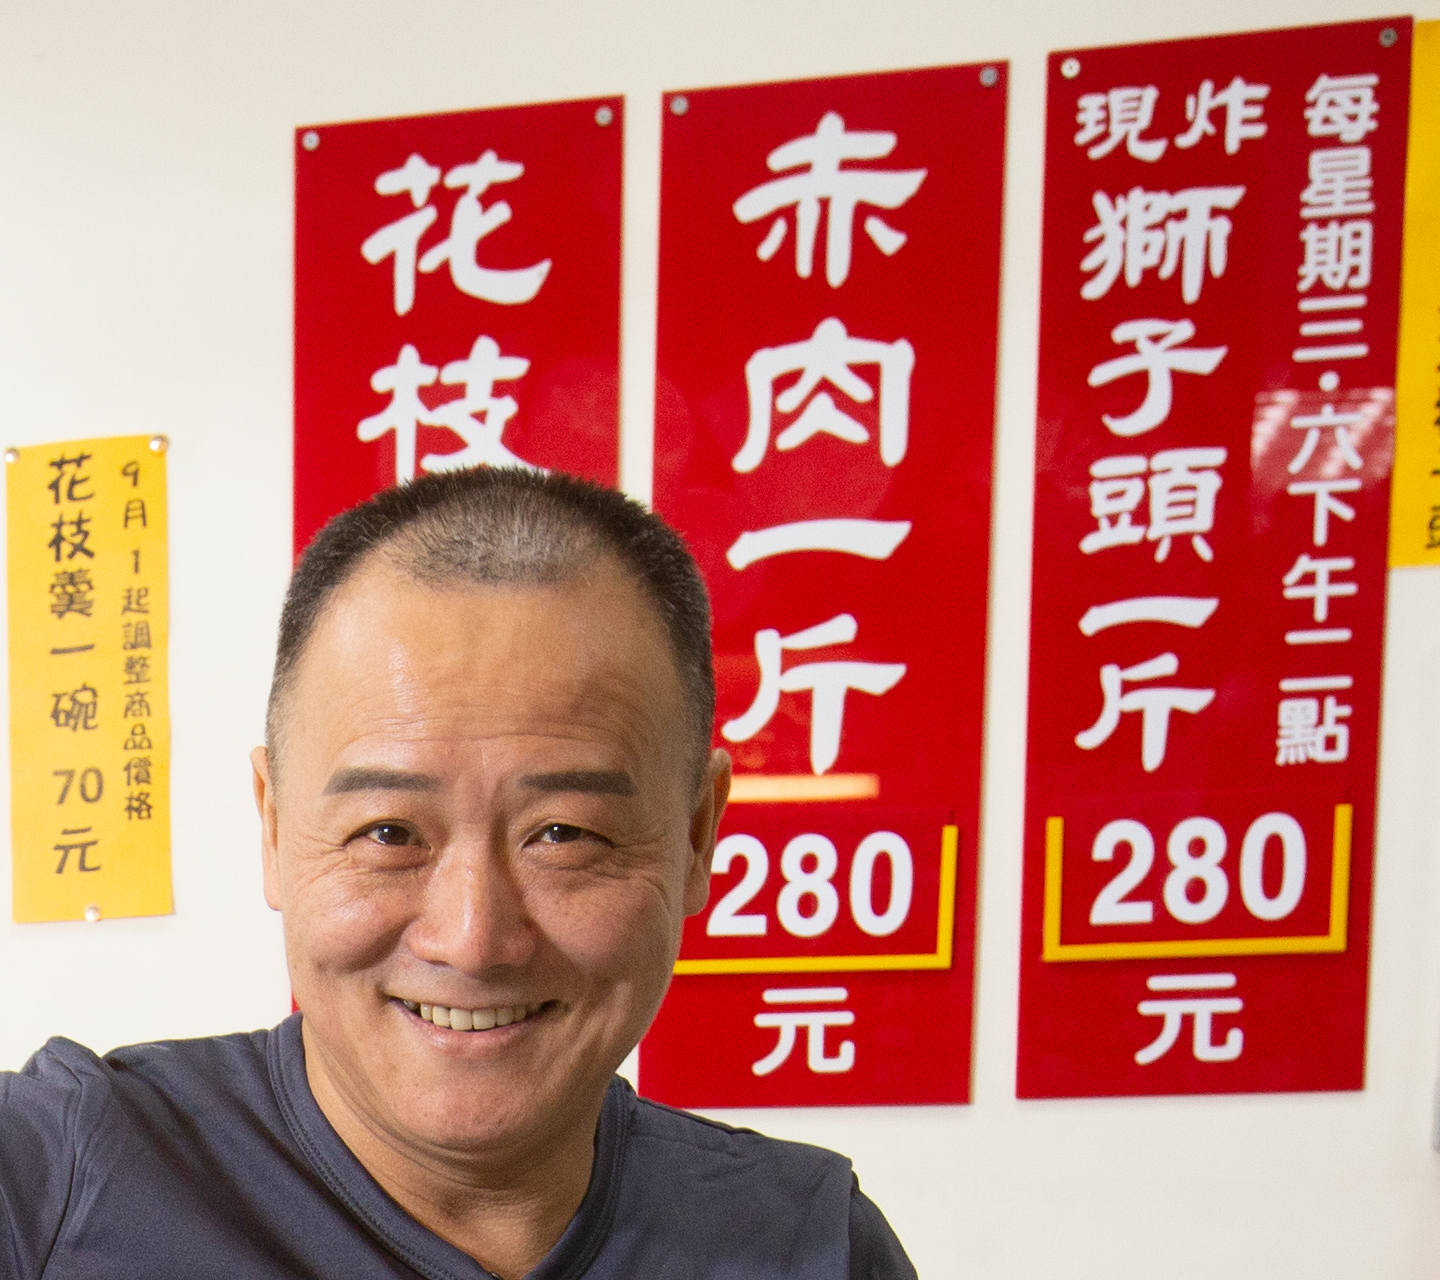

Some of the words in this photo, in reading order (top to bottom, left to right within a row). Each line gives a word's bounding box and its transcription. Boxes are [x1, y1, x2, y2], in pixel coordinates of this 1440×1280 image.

[1074, 77, 1270, 163] 現炸
[356, 147, 558, 473] 花枝
[722, 108, 930, 778] 赤肉一斤
[1074, 186, 1246, 772] 獅子頭一斤
[706, 831, 913, 938] 280
[1089, 812, 1307, 926] 280
[751, 987, 855, 1076] 元
[1134, 973, 1244, 1065] 元
